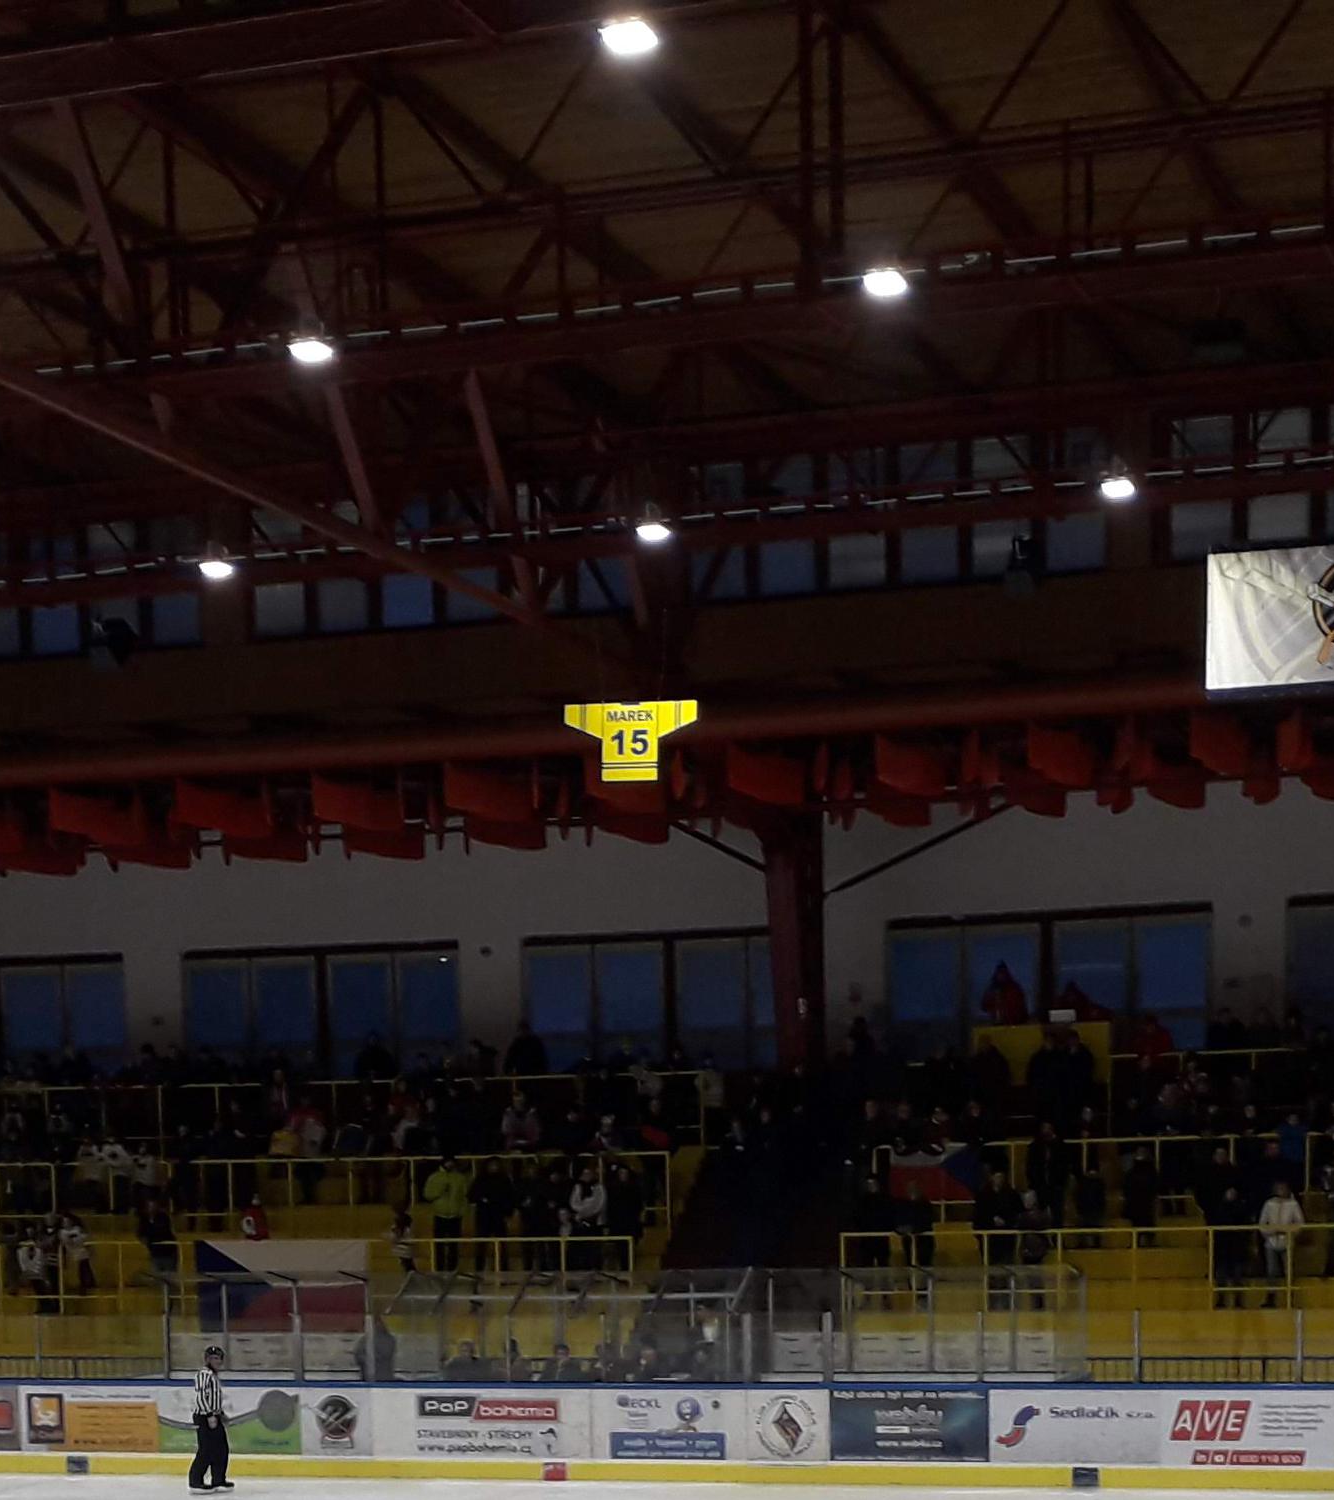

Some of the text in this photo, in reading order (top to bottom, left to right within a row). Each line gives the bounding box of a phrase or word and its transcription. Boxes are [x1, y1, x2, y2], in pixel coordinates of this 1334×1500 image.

[605, 709, 654, 723] MAREK
[611, 729, 649, 756] 15
[1174, 1409, 1247, 1432] AVE
